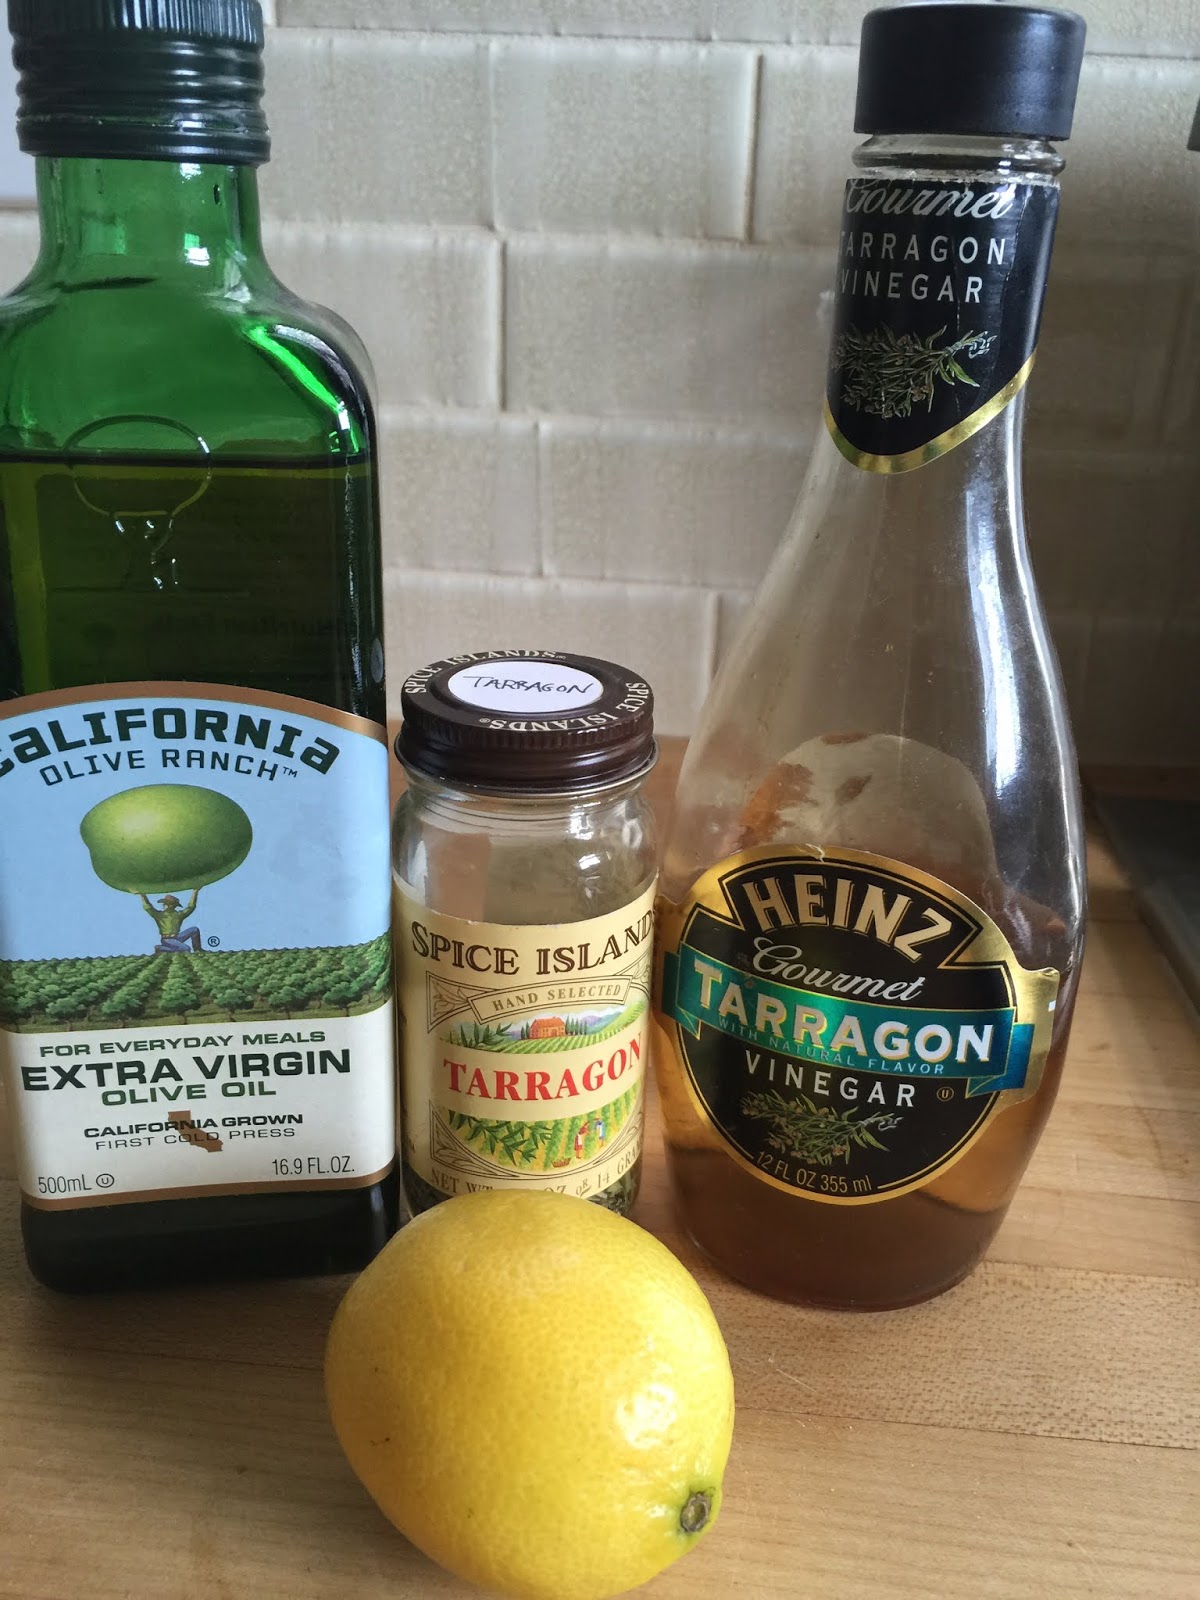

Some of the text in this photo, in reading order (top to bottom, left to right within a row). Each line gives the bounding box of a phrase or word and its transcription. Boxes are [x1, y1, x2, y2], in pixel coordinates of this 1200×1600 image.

[846, 178, 1017, 219] Gourmet
[840, 231, 1006, 265] TARRAGON
[841, 269, 983, 303] VINEGAR
[405, 664, 442, 694] SPICE
[463, 676, 594, 694] TARRAGON
[616, 682, 649, 712] SPICE
[39, 749, 146, 786] OLIVE
[741, 873, 952, 962] HEINZ
[411, 921, 520, 975] SPICE
[752, 936, 925, 1001] Gourmet
[492, 984, 622, 1012] HAND SELECTED
[694, 958, 994, 1064] TARRAGON
[40, 1030, 326, 1058] FOR EVERYDAY MEALS
[719, 1017, 945, 1076] WITH NATURAL FLAVOR
[20, 1048, 351, 1092] EXTRA VIRGIN
[745, 1050, 916, 1108] VINEGAR
[101, 1080, 277, 1106] OLIVE OIL
[83, 1114, 304, 1138] CALIFORNIA GROWN
[95, 1127, 296, 1150] FIRST COLD PRESS
[271, 1156, 304, 1176] 16.9
[431, 1168, 460, 1193] NET
[597, 1171, 610, 1188] 14
[756, 1151, 873, 1193] 12 FL OZ 355 ml
[37, 1175, 93, 1194] 500mL
